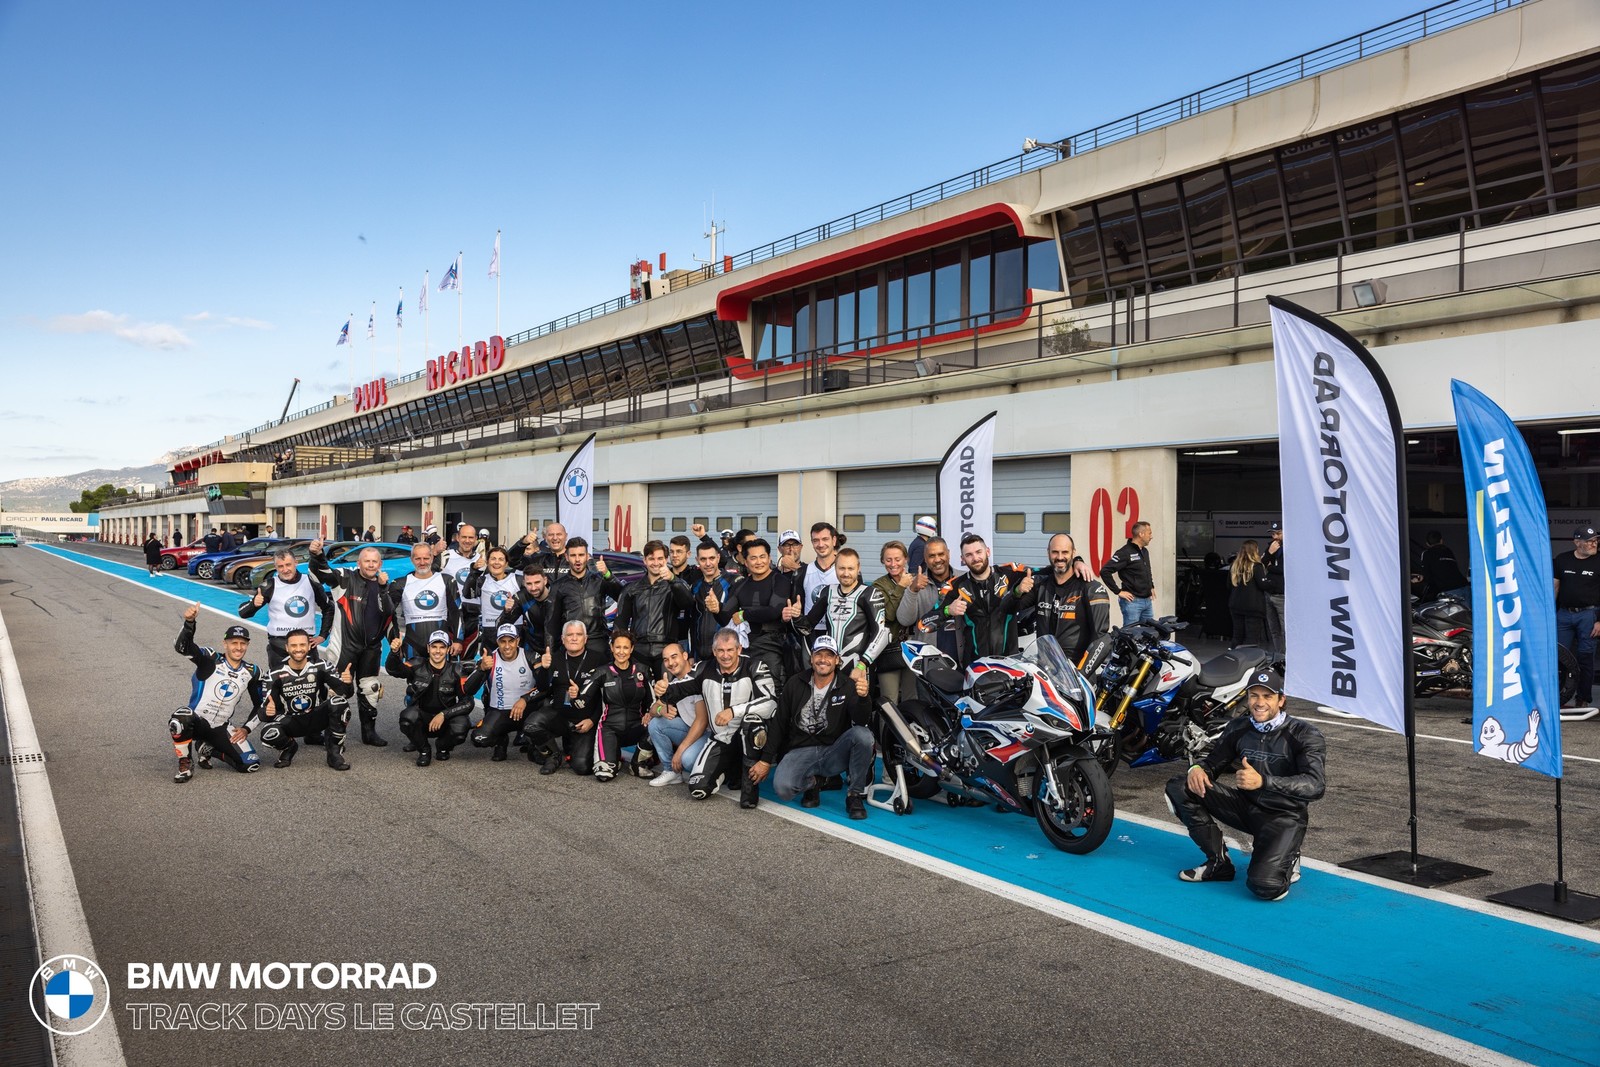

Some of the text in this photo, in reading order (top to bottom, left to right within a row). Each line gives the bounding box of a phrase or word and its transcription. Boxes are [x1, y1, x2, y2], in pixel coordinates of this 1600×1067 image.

[353, 335, 506, 413] PAUL RICARD
[614, 504, 632, 553] 04
[959, 445, 975, 566] TORRAD
[282, 684, 302, 692] MOTO
[283, 688, 316, 697] TOULOUSE
